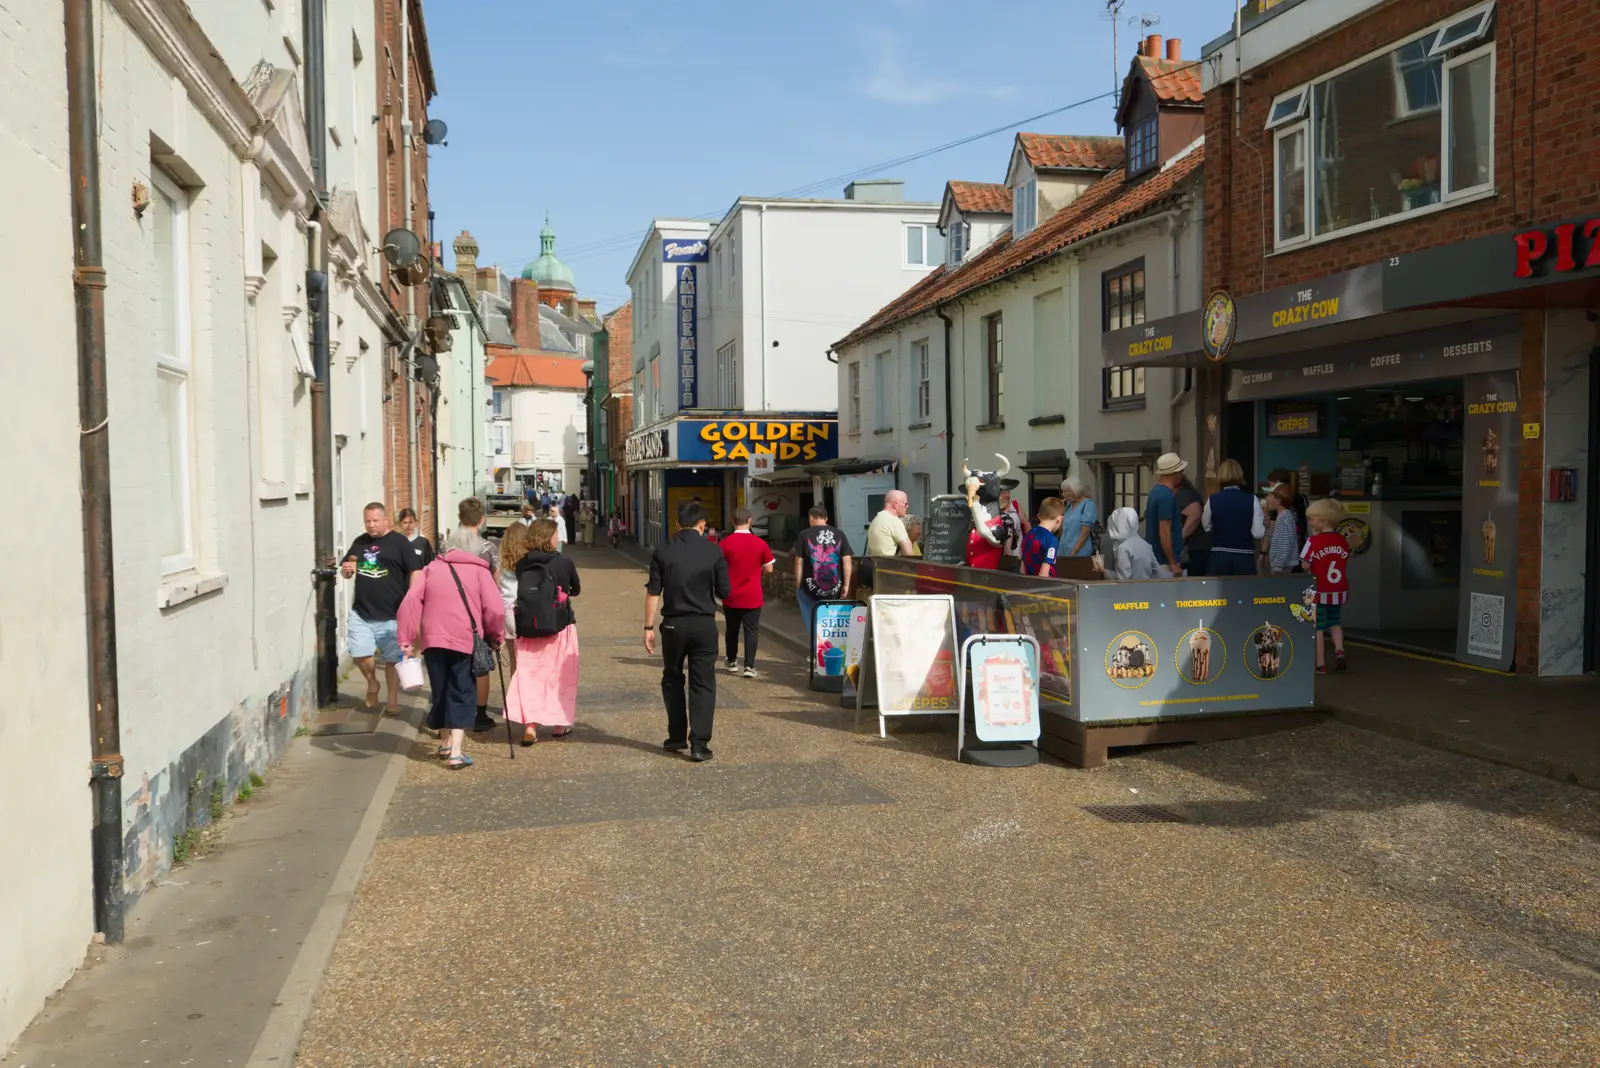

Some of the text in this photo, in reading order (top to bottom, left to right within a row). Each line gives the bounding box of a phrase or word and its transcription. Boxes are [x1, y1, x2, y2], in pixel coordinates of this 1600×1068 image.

[1389, 256, 1400, 267] 23
[1297, 289, 1312, 303] THE
[1272, 297, 1340, 328] CRAZY COW
[680, 267, 695, 406] AMUSEMENTS
[1145, 328, 1155, 338] THE
[1128, 335, 1173, 357] CRAZY COW
[1241, 340, 1492, 385] ICE CREAM WAFFLES COFFEE DESSERTS
[1486, 393, 1498, 402] THE
[1468, 401, 1517, 415] CRAZY COW
[700, 422, 829, 441] GOLDEN
[1277, 415, 1309, 432] CRÊPES
[711, 441, 817, 461] SANDS
[1326, 560, 1342, 584] 6
[1113, 596, 1286, 611] WAFFLES THICKSHAKES SUNDAES
[821, 618, 850, 628] SLUS
[822, 629, 847, 638] Drin
[893, 694, 949, 710] CRÊPES
